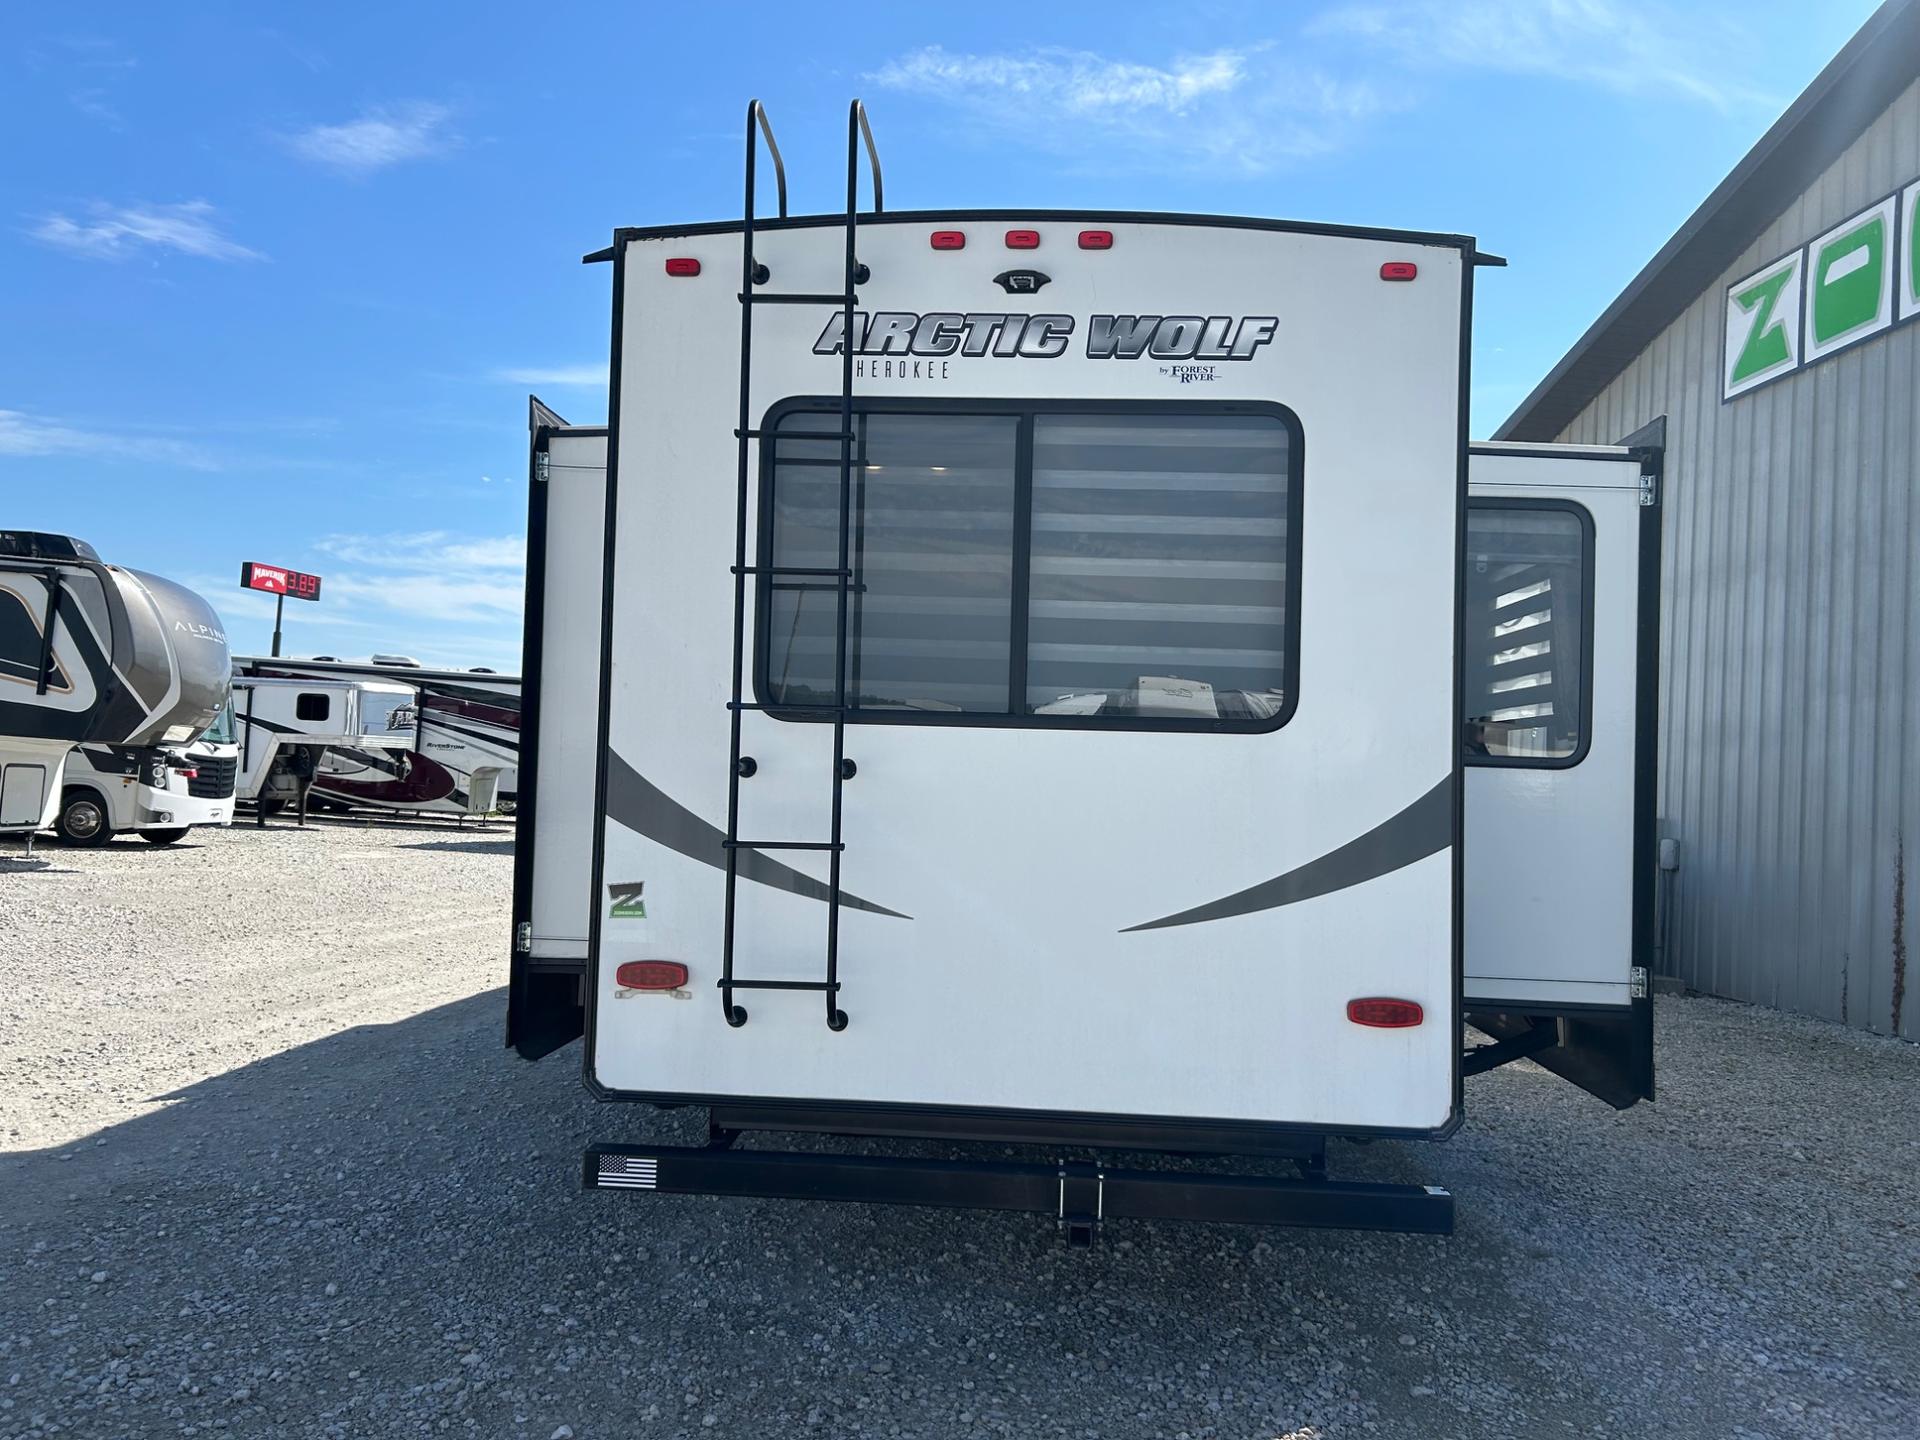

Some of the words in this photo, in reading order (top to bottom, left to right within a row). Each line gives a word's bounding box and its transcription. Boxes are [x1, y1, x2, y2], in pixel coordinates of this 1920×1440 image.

[1729, 188, 1920, 389] ZO
[812, 311, 1075, 357] ARCTIC
[1086, 314, 1279, 361] WOLF
[845, 360, 949, 379] HEROKEE
[1159, 367, 1169, 375] by
[1171, 365, 1216, 377] FOREST
[1180, 373, 1215, 384] RIVER
[253, 566, 286, 587] MAVERIK
